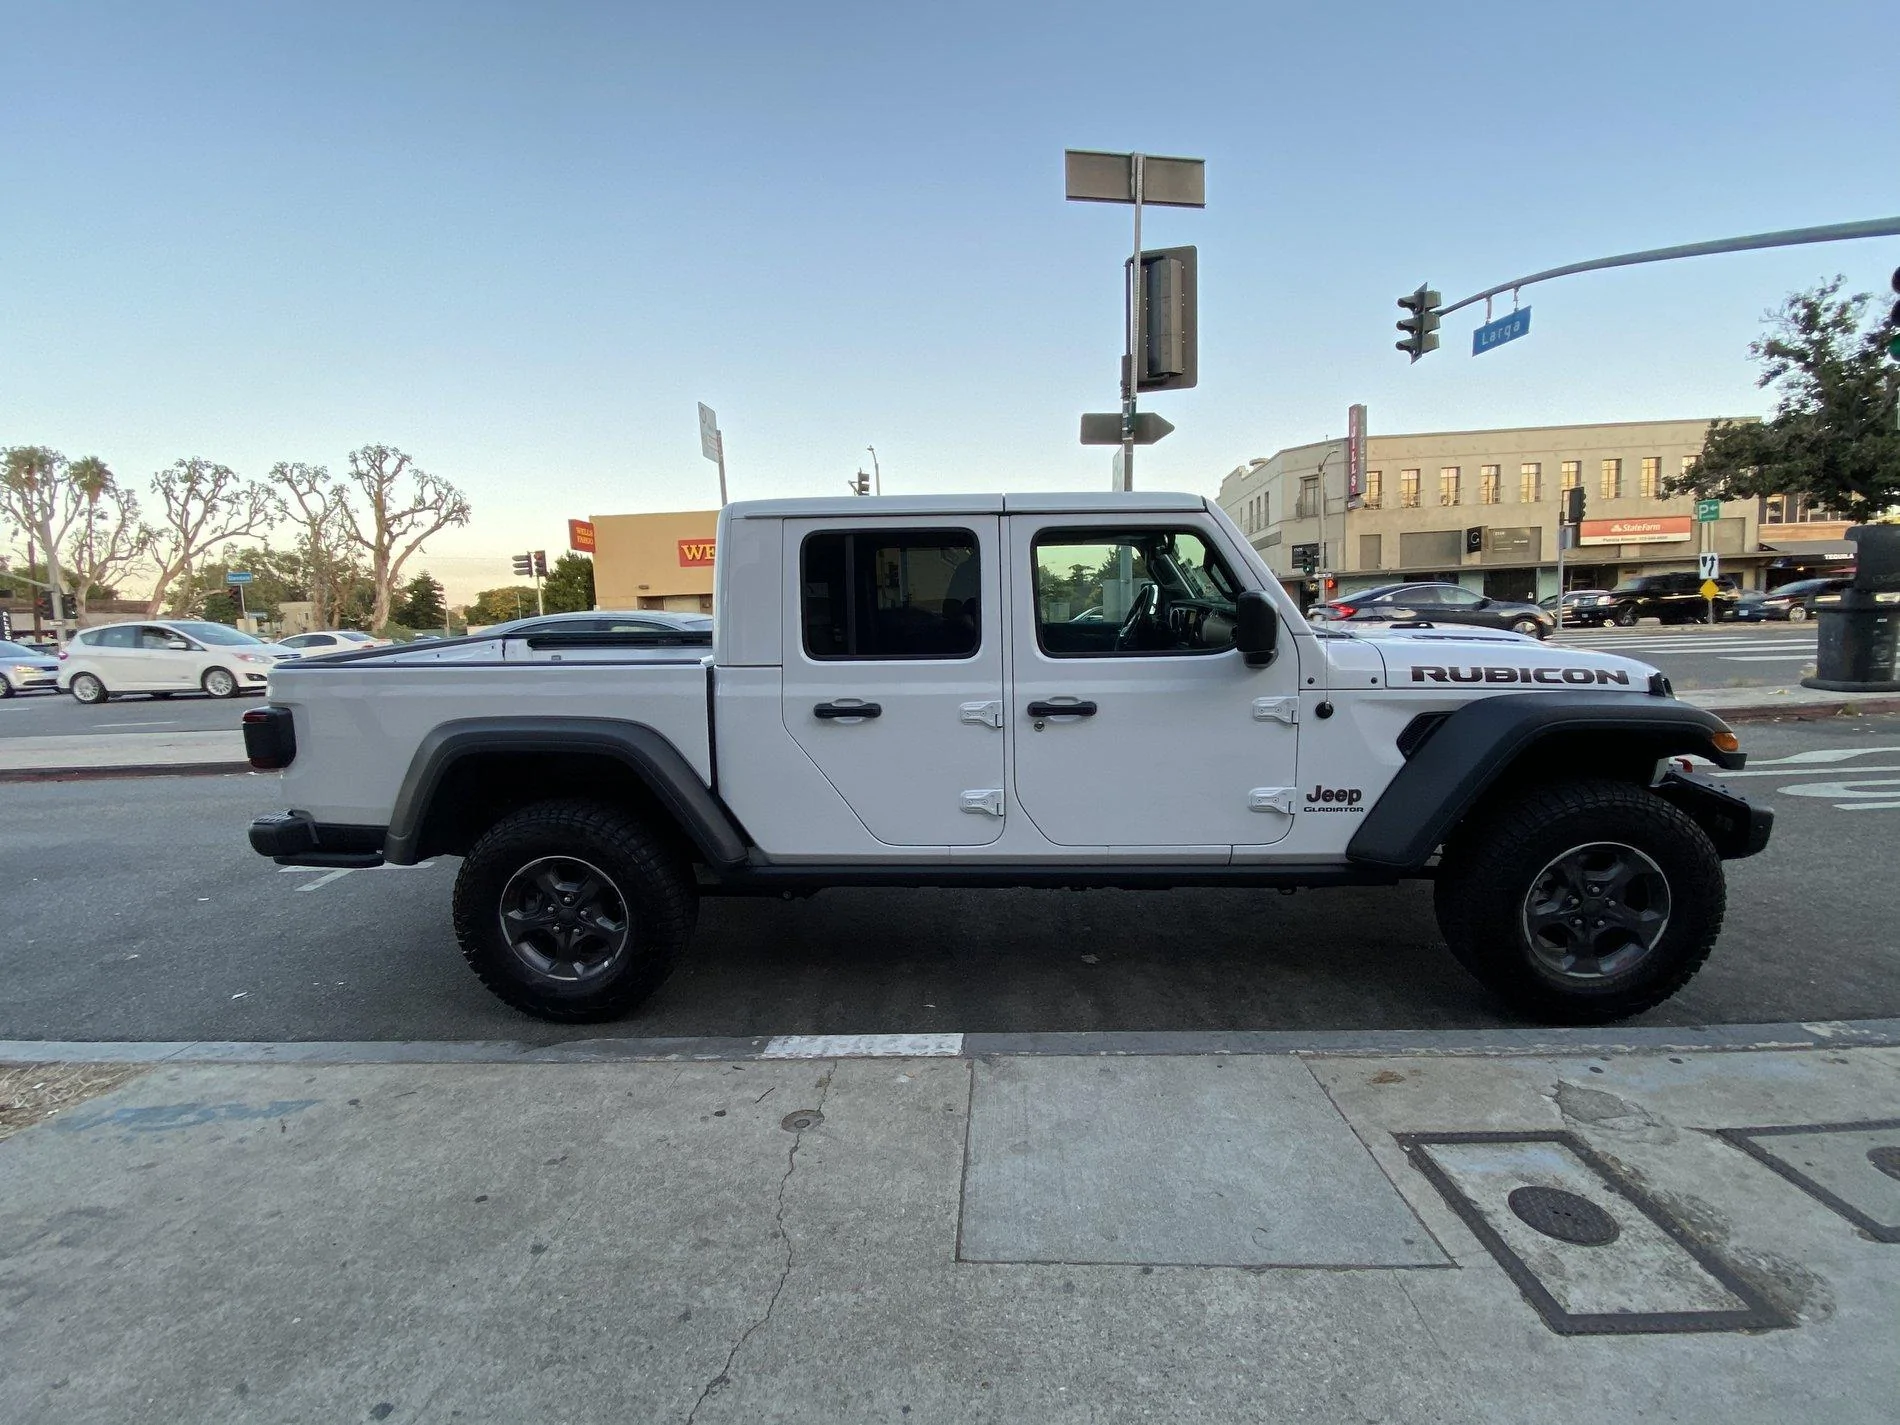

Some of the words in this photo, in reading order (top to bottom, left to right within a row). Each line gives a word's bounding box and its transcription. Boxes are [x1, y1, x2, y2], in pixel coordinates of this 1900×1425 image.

[1482, 320, 1520, 345] Larga
[576, 526, 593, 537] WELLS
[1411, 666, 1630, 685] RUBICON
[1306, 784, 1362, 806] Jeep
